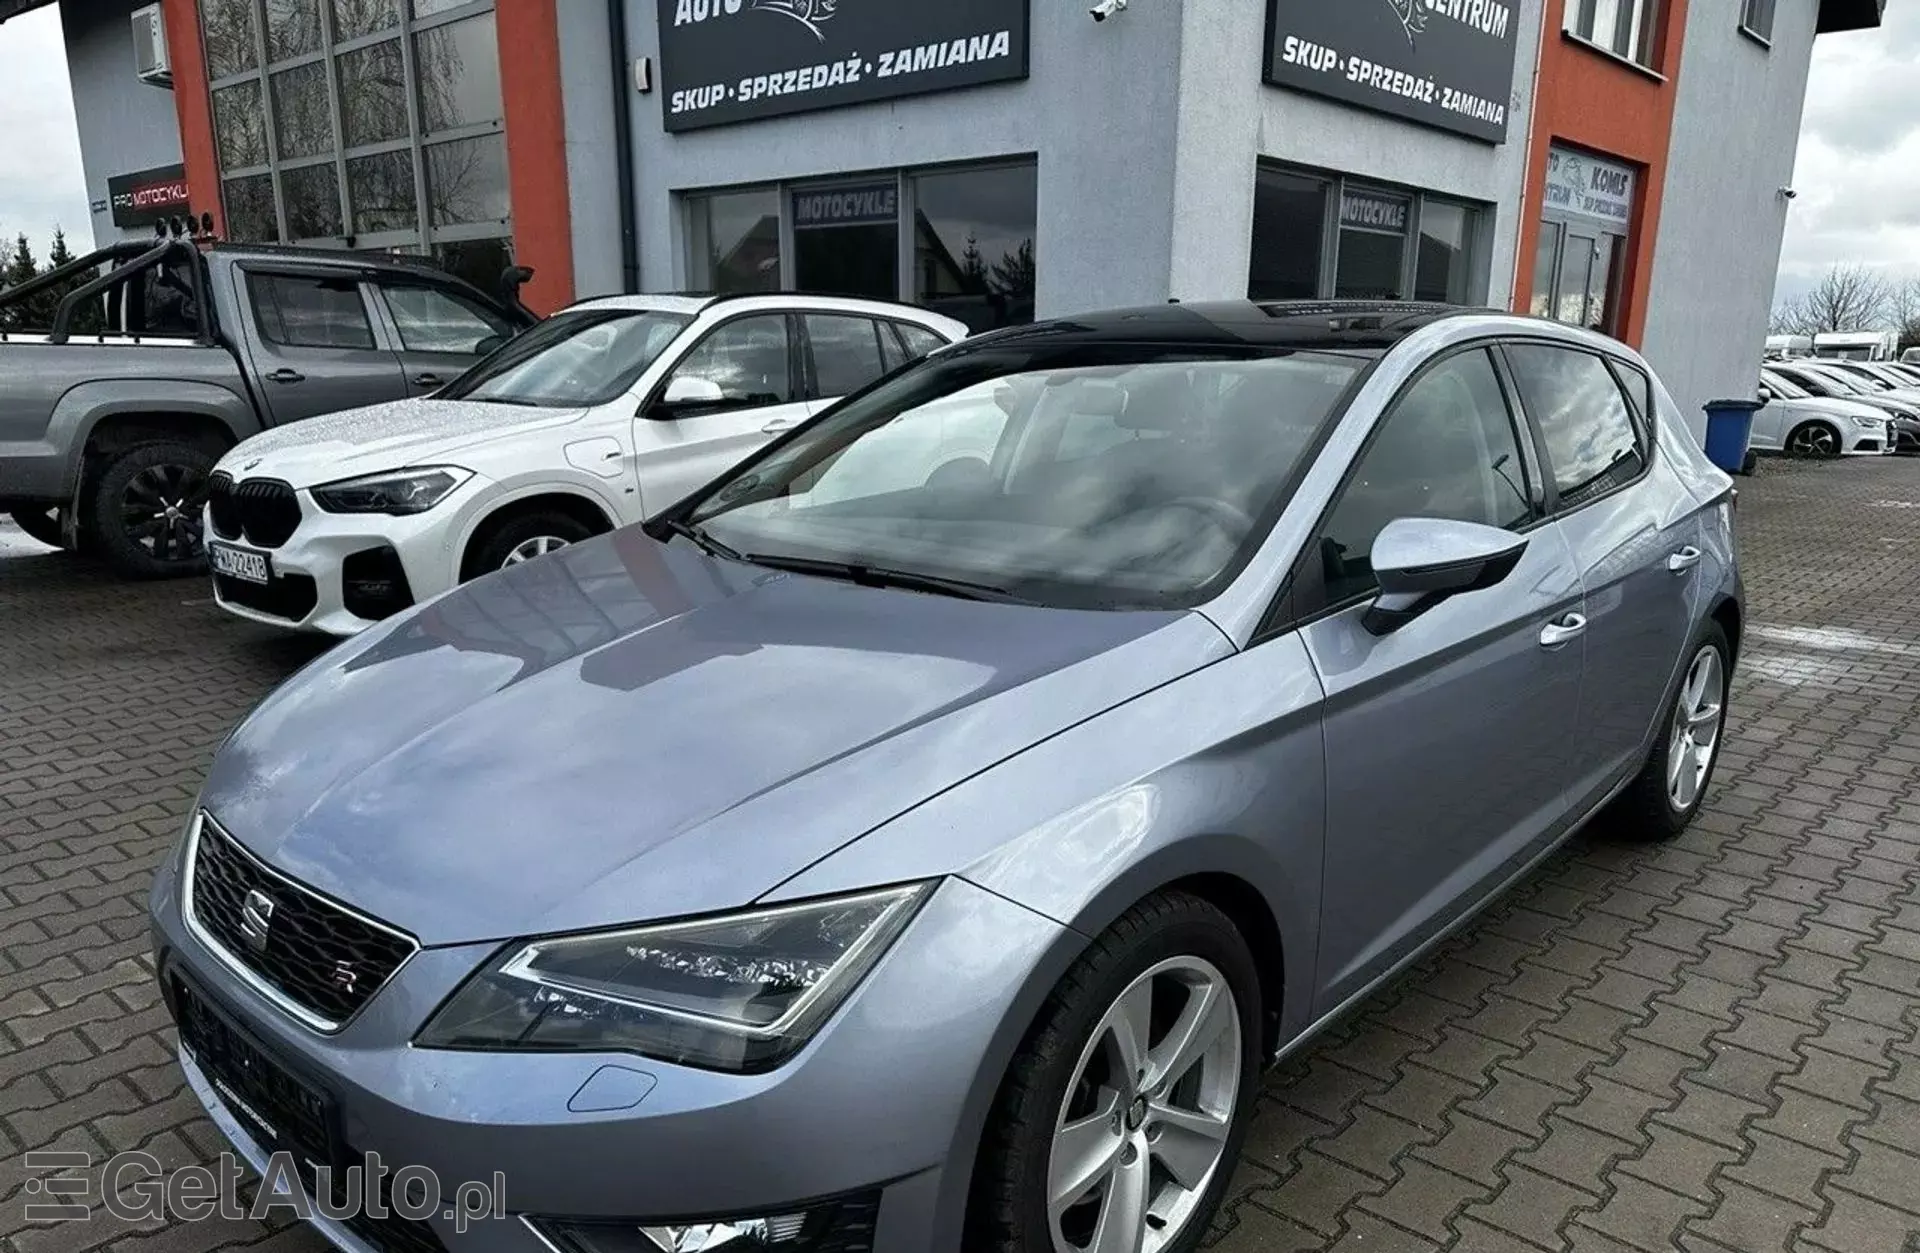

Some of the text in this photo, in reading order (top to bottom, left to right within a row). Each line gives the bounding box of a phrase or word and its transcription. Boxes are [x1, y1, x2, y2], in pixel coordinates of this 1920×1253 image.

[671, 30, 1010, 114] SKUP SPRZEDAŻ ZAMIANA
[1282, 35, 1505, 126] SKUP SPRZEDAŻ ZAMIANA
[797, 190, 895, 220] MOTOCYKLE
